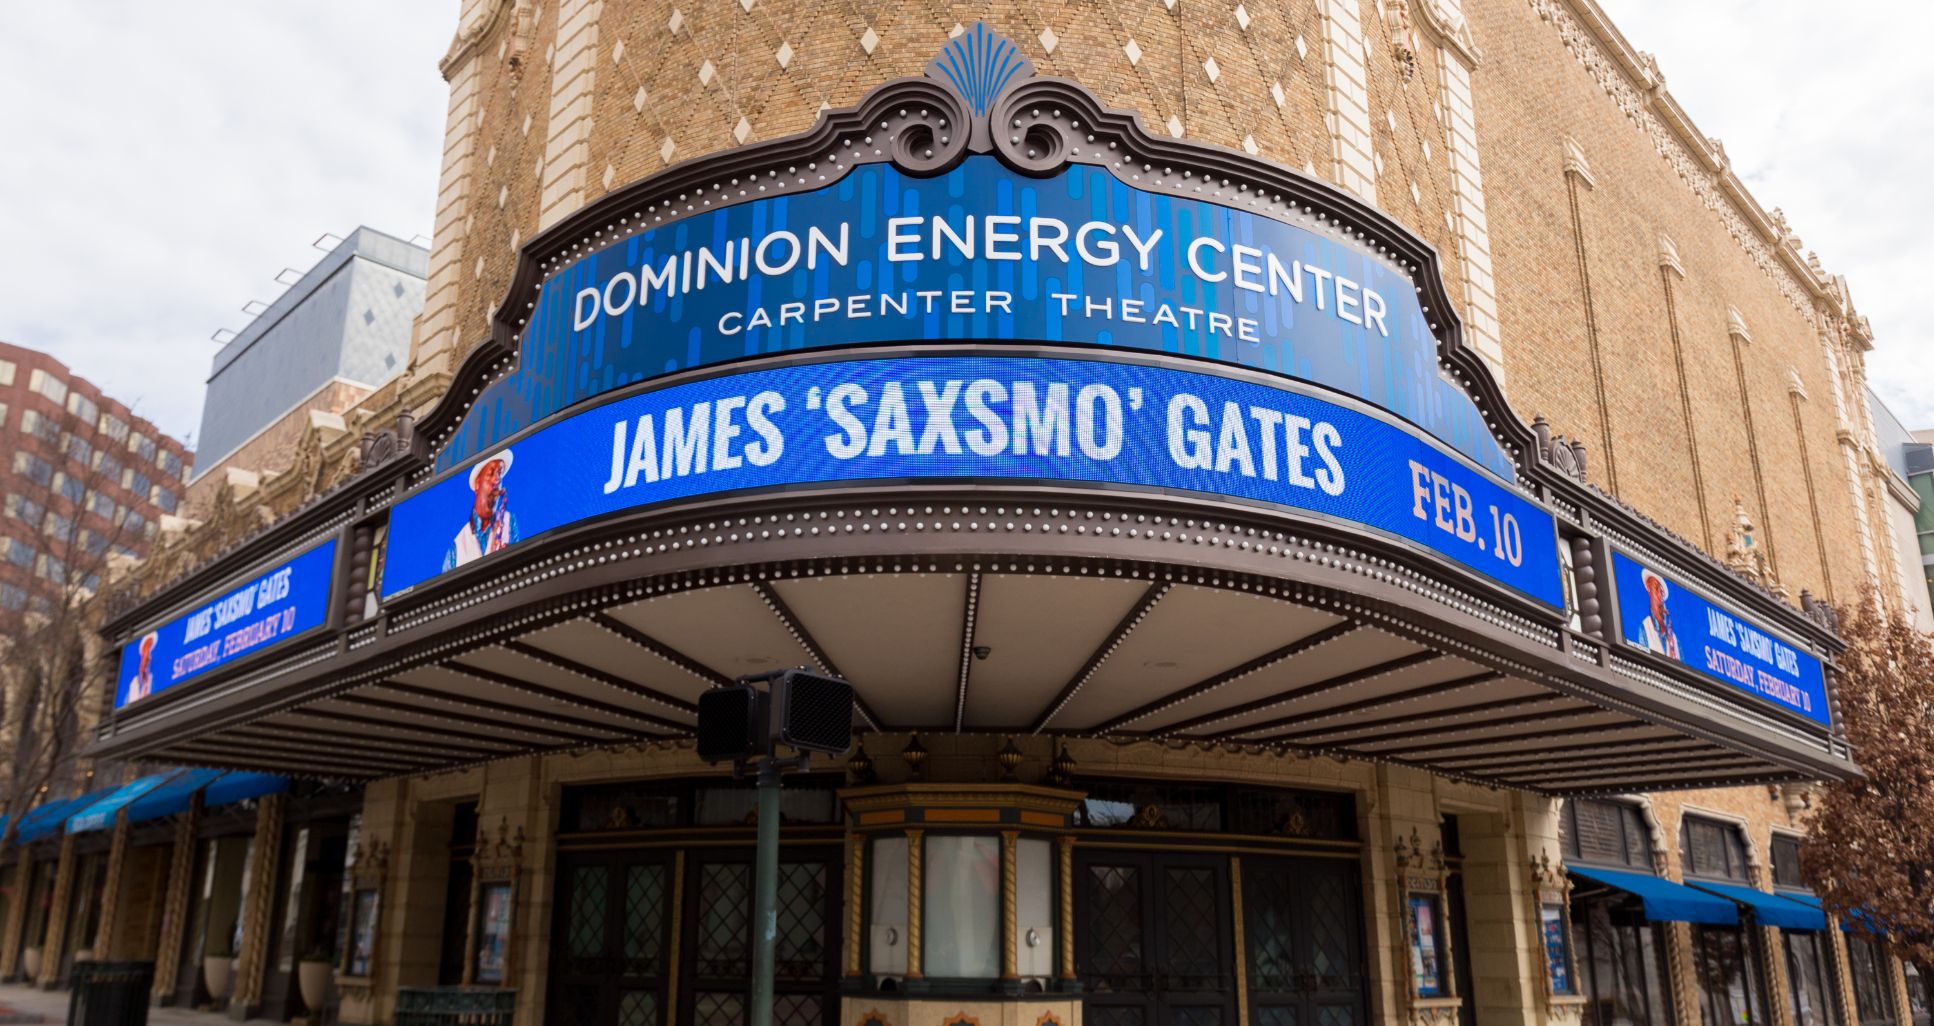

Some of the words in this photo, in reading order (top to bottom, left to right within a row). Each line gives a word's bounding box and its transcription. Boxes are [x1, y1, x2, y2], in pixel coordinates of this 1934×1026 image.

[574, 222, 849, 332] DOMINION
[887, 214, 1163, 271] ENERGY
[1187, 236, 1389, 337] CENTER
[718, 290, 1012, 336] CARPENTER
[1051, 293, 1261, 343] THEATRE
[604, 391, 786, 494] JAMES
[806, 379, 1143, 461] ‘SAXSMO’
[1166, 393, 1345, 496] GATES
[1408, 459, 1486, 551] FEB.
[1489, 505, 1522, 568] 10
[183, 606, 214, 645] JAMES
[257, 566, 293, 610] GATES
[222, 612, 282, 658] FEBRUARY
[281, 606, 296, 634] 10
[1706, 606, 1737, 648] JAMES
[1774, 641, 1800, 678] GATES
[1757, 669, 1802, 708] FEBRUARY
[1800, 689, 1812, 713] 10
